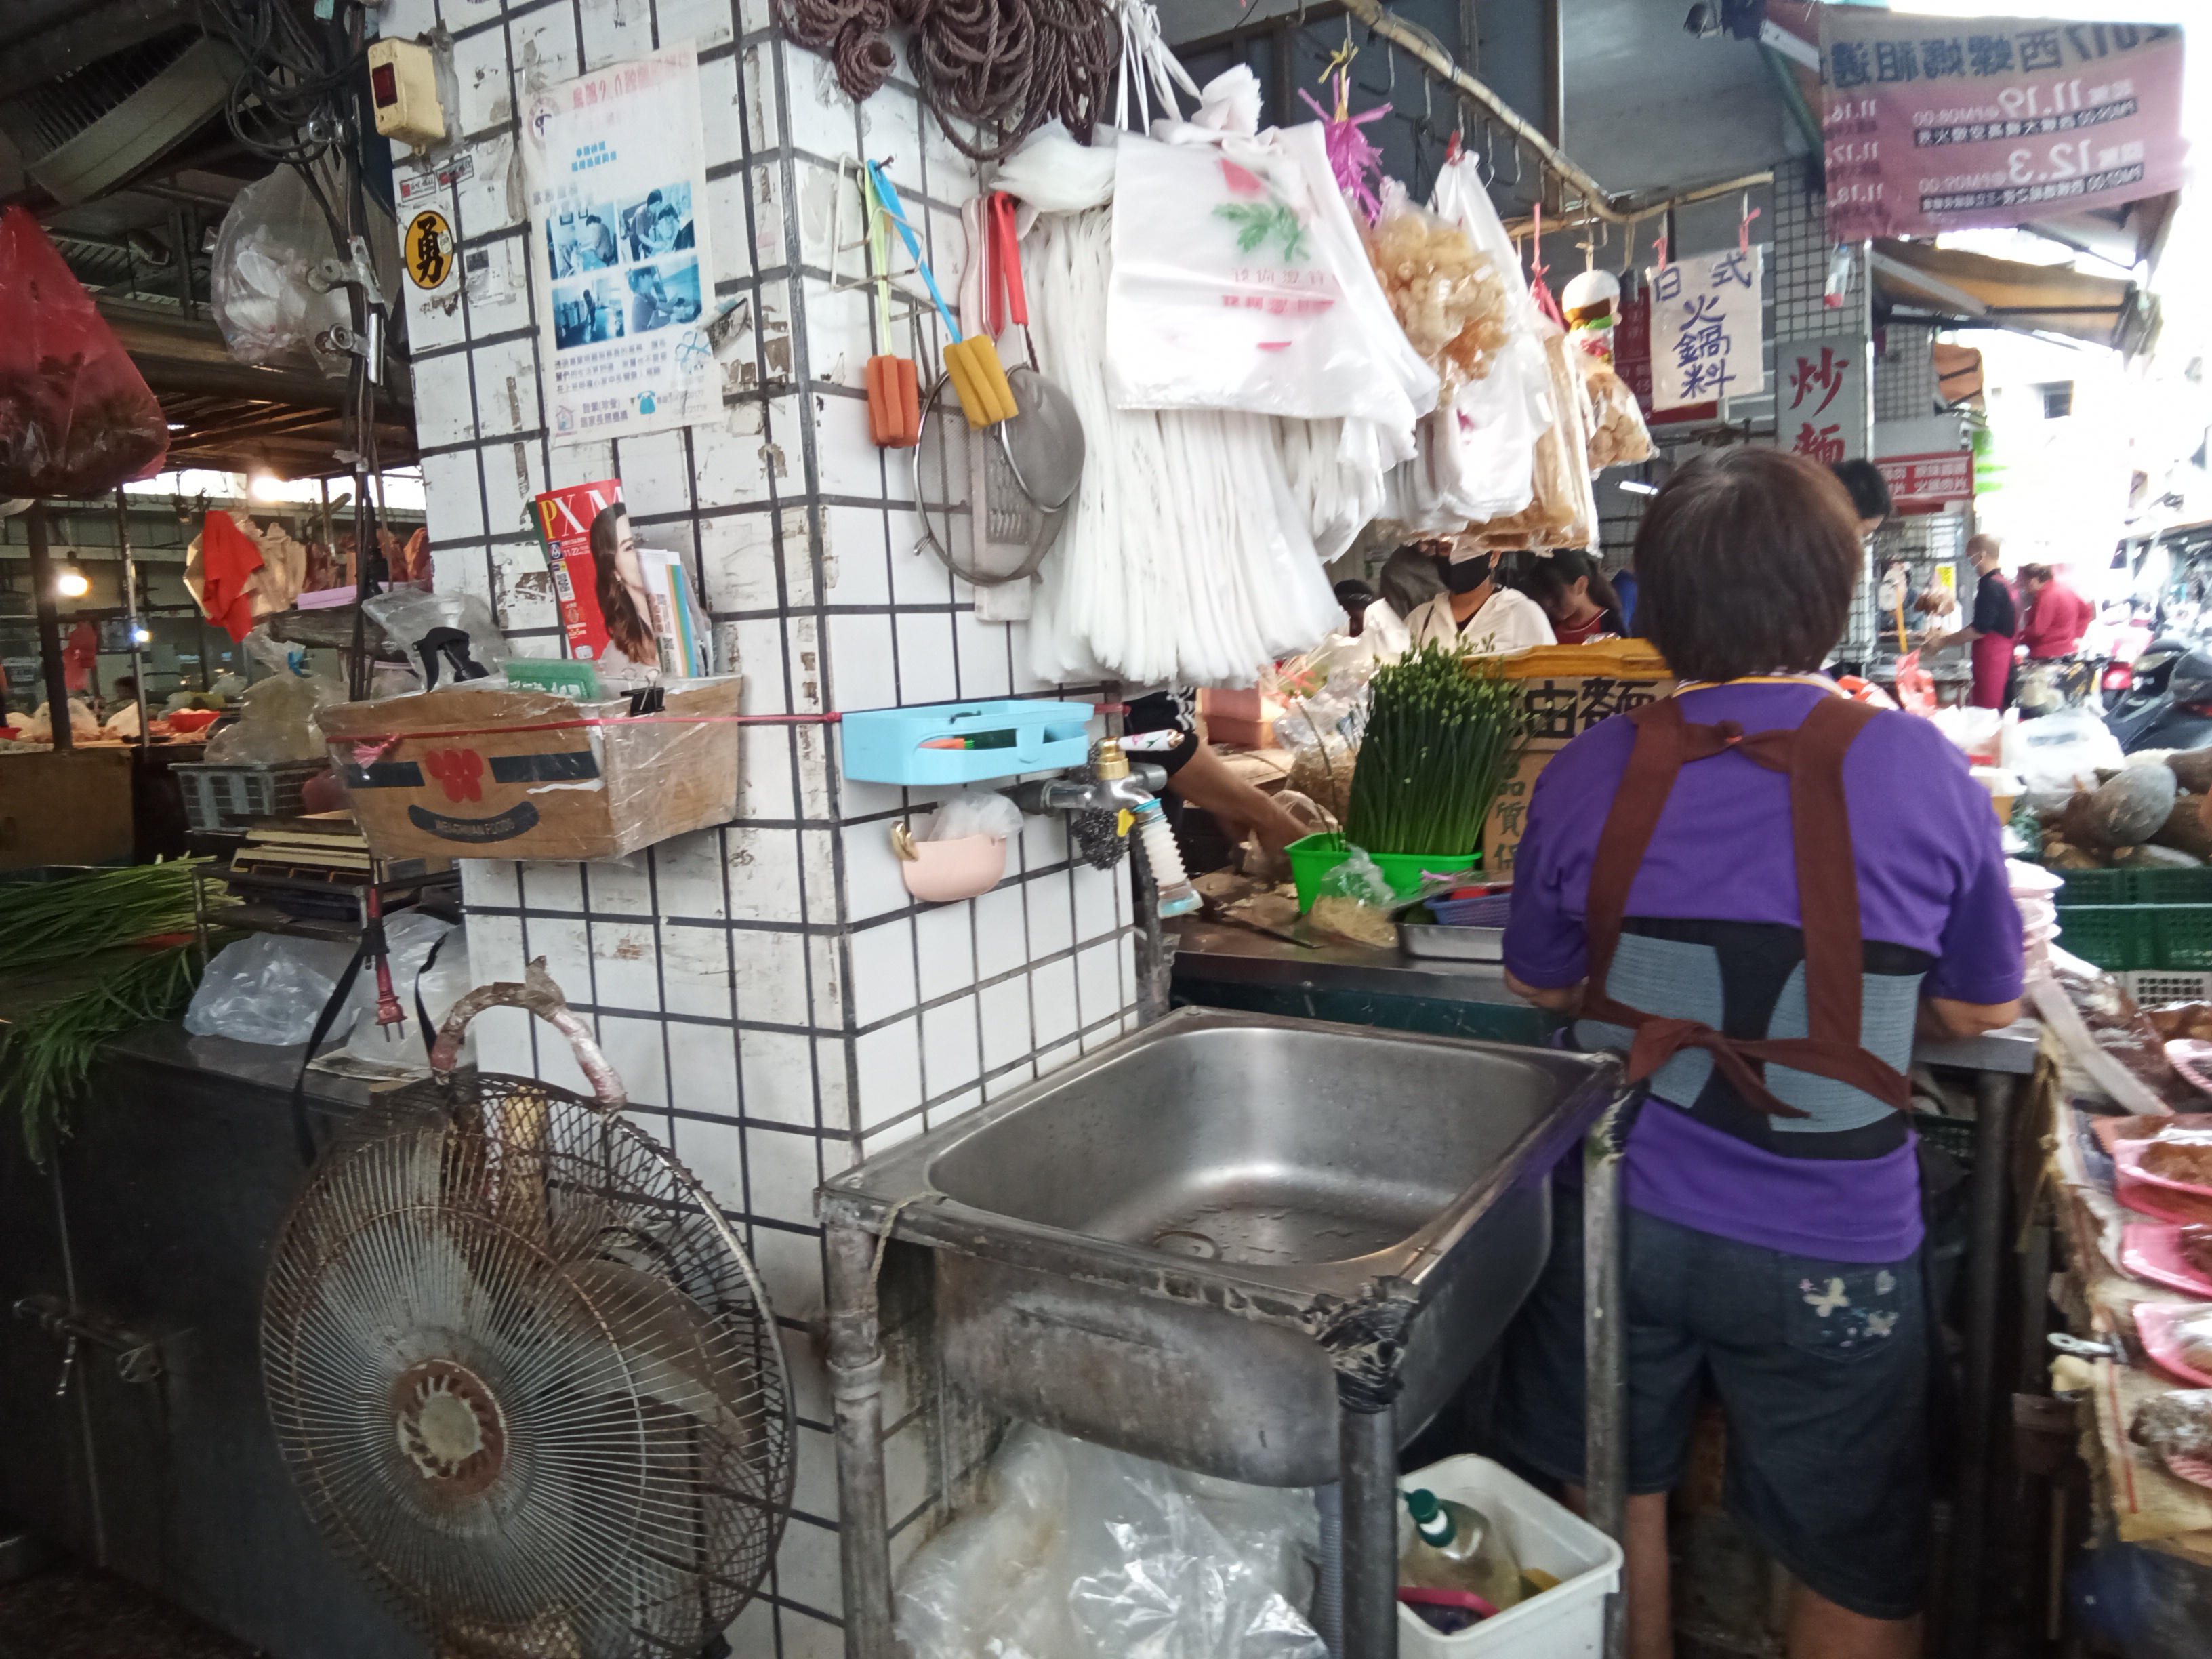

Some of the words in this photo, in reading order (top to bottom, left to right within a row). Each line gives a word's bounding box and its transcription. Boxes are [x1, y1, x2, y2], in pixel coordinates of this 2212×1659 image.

[417, 216, 445, 285] 勇
[1654, 251, 1753, 302] 日式
[1672, 293, 1736, 398] 火鍋料
